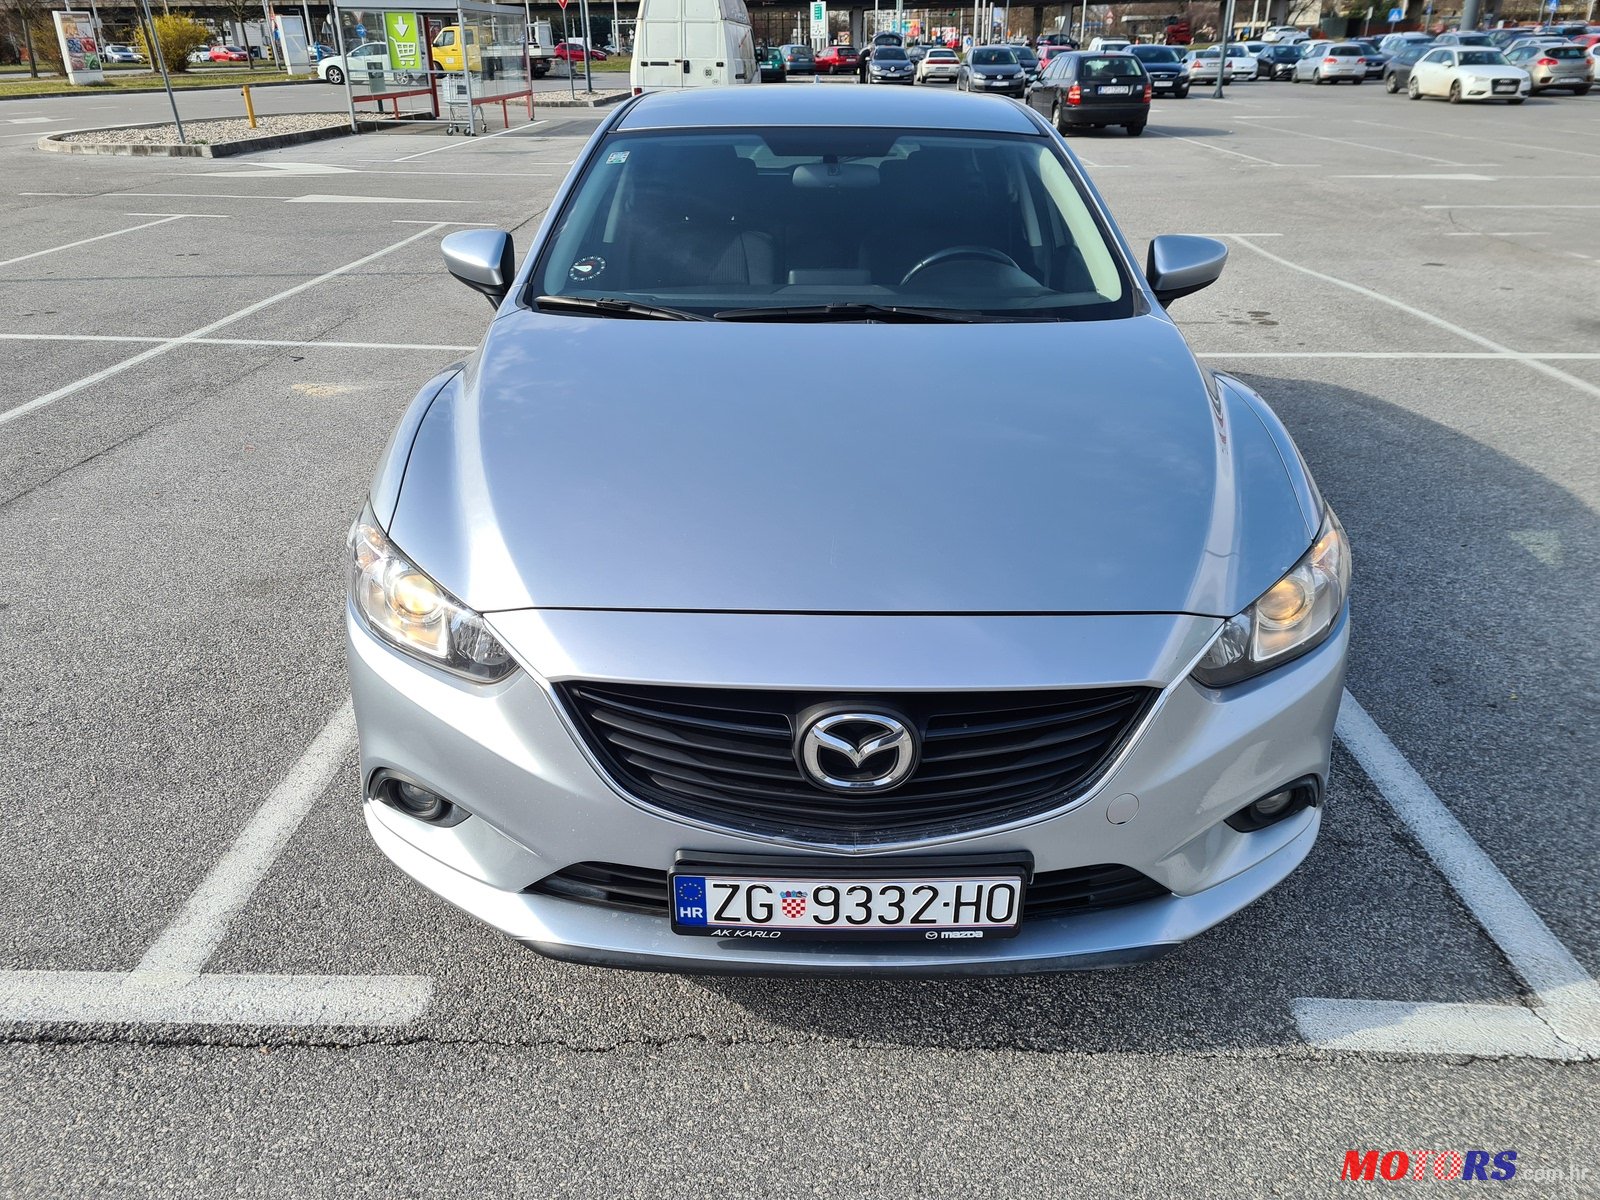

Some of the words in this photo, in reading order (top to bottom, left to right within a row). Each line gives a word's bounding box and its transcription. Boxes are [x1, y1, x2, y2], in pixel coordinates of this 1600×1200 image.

[712, 883, 774, 924] ZG
[679, 906, 704, 919] HR
[711, 929, 732, 938] AK
[733, 929, 782, 939] KARLO
[940, 930, 984, 939] mazda
